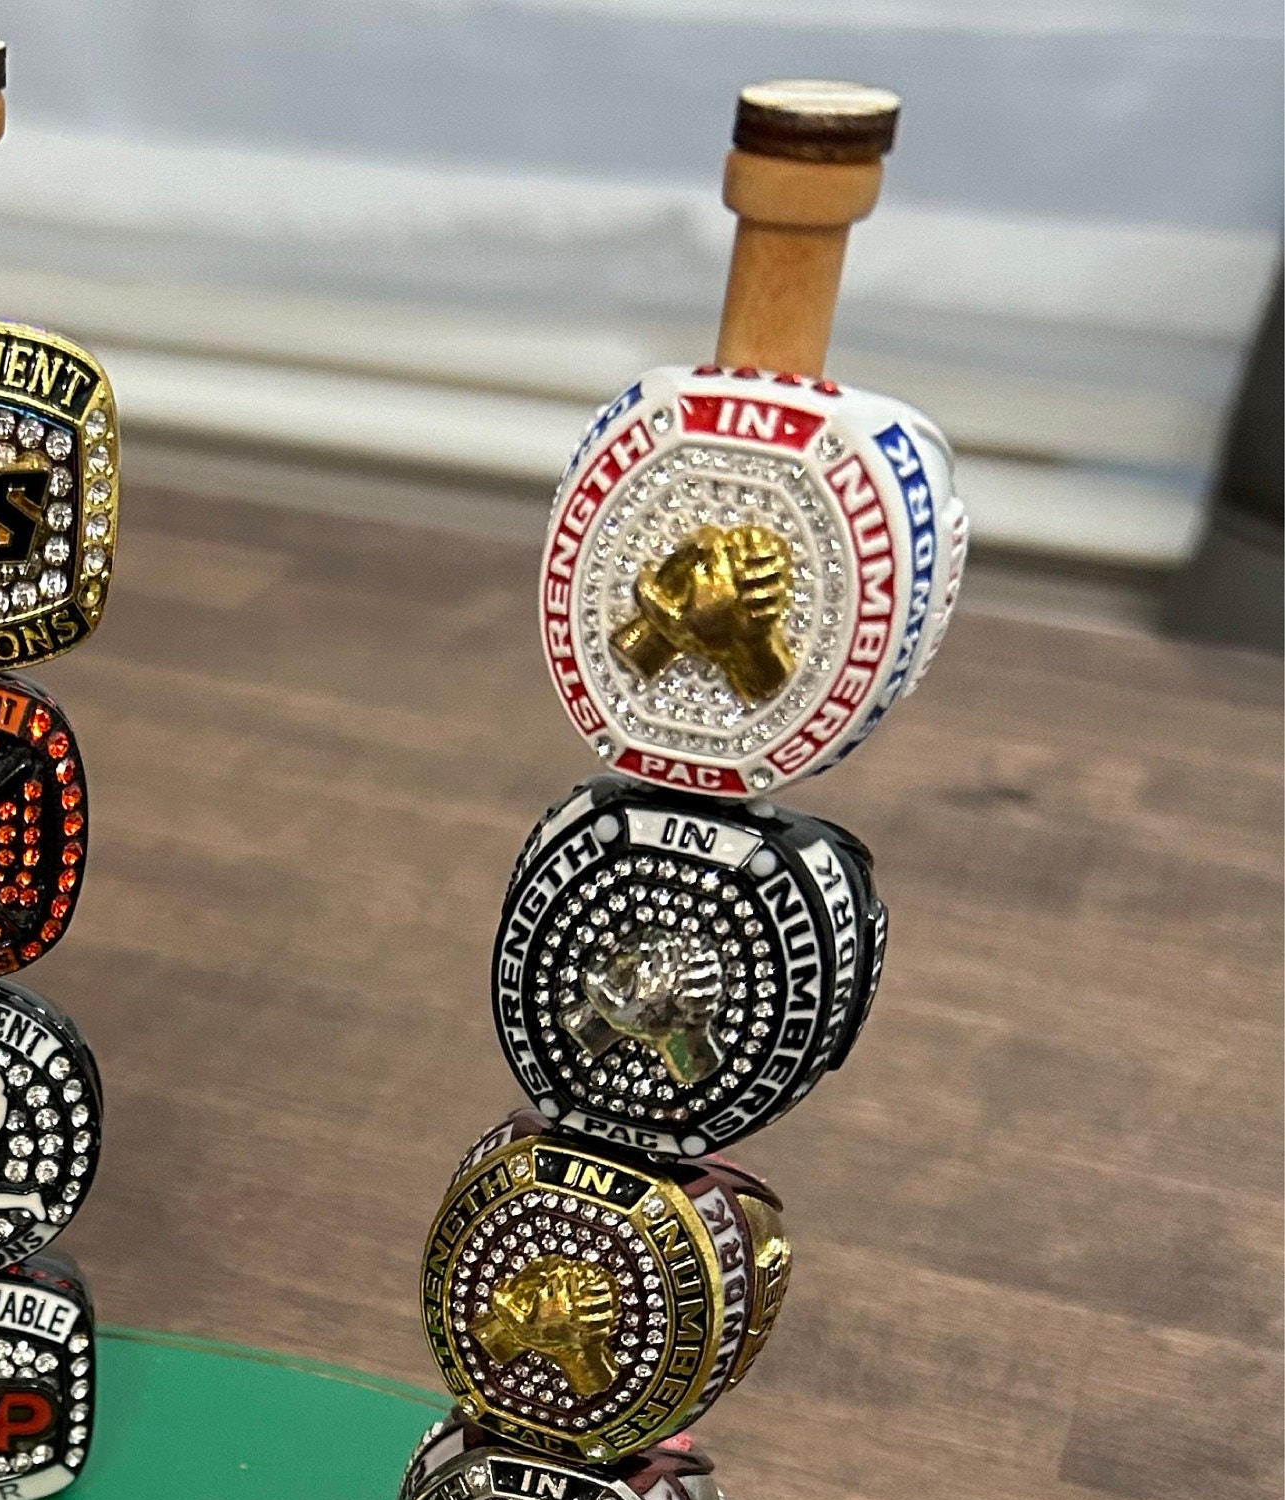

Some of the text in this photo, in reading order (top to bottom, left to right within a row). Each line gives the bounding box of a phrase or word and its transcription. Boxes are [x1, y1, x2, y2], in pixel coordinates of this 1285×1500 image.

[545, 425, 652, 733] STRENGTH
[716, 402, 781, 439] IN
[774, 458, 894, 773] NUMBERS
[640, 757, 722, 792] PAC
[501, 818, 820, 1138] STRENGTH IN NUMBERS
[584, 1115, 659, 1149] PAC
[425, 1166, 512, 1396] STRENGTH
[563, 1159, 615, 1196] IN
[604, 1217, 707, 1451] NUMBERS
[520, 1468, 567, 1500] IN
